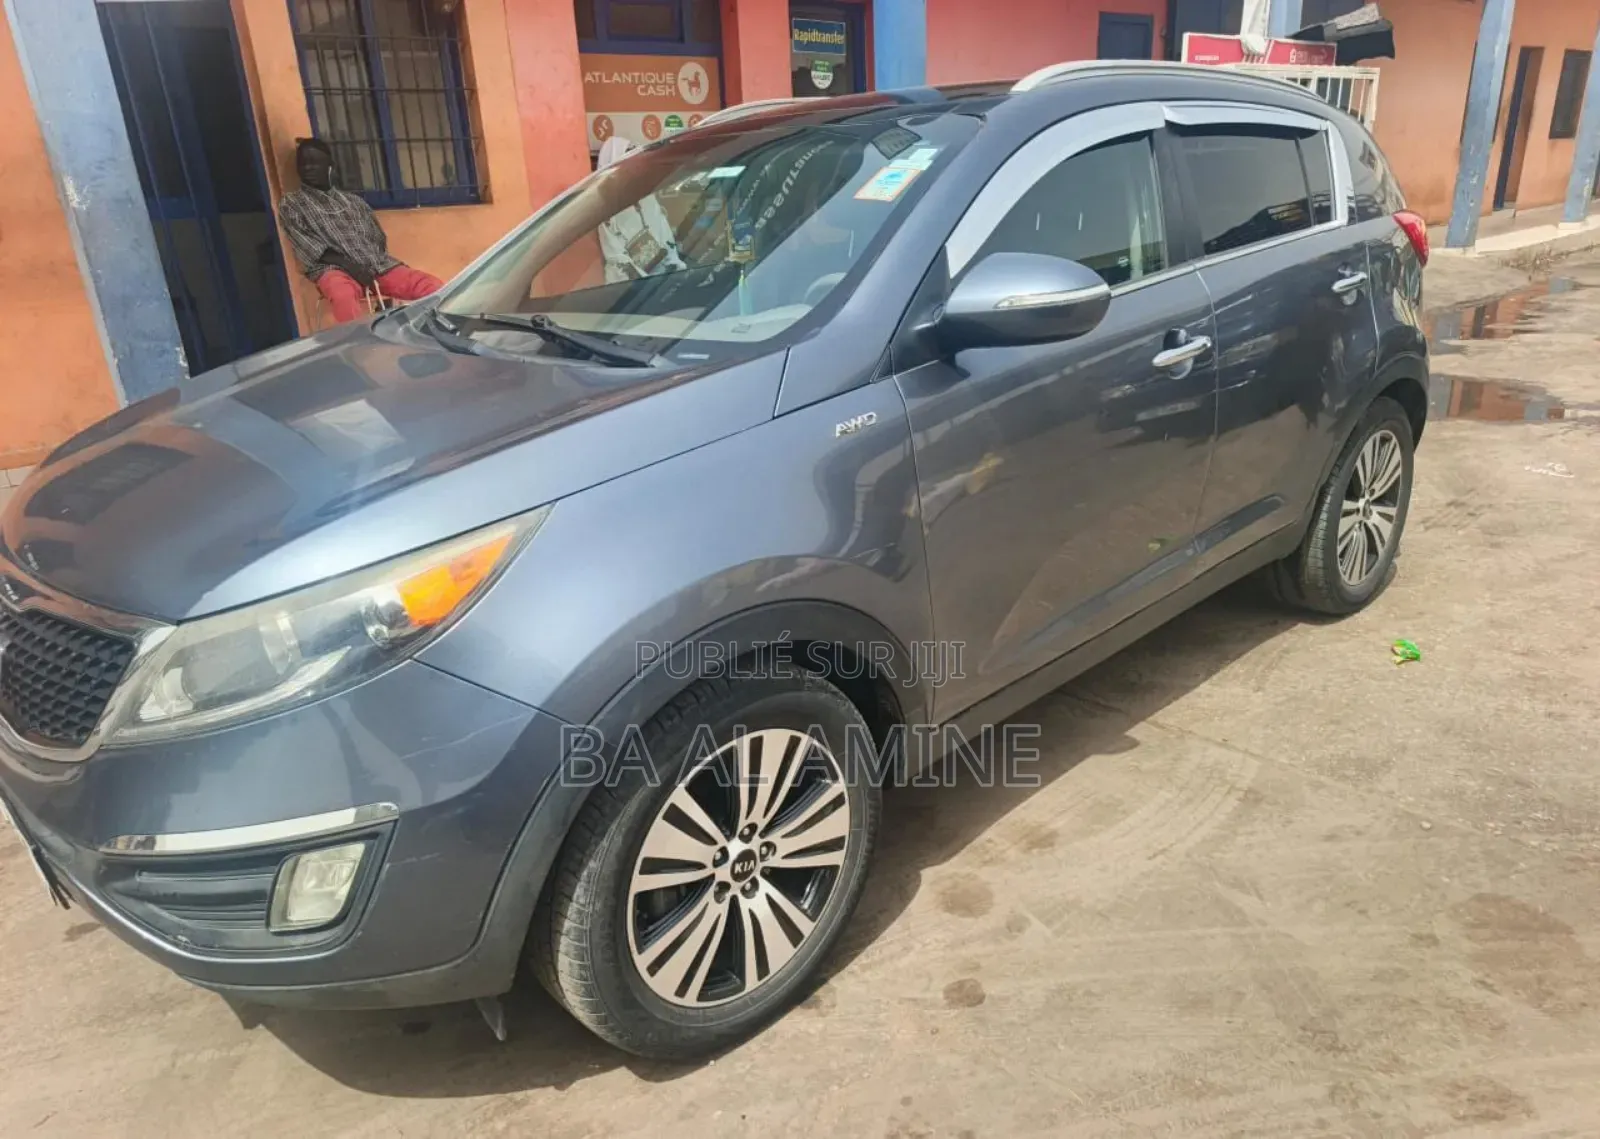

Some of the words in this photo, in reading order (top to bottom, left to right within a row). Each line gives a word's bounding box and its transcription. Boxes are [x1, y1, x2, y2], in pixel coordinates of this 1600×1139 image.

[794, 28, 845, 46] Rapidtransfer
[584, 71, 675, 84] ATLANTIQUE
[637, 84, 676, 97] CASH
[835, 411, 877, 438] AWD
[734, 859, 755, 875] KIA
